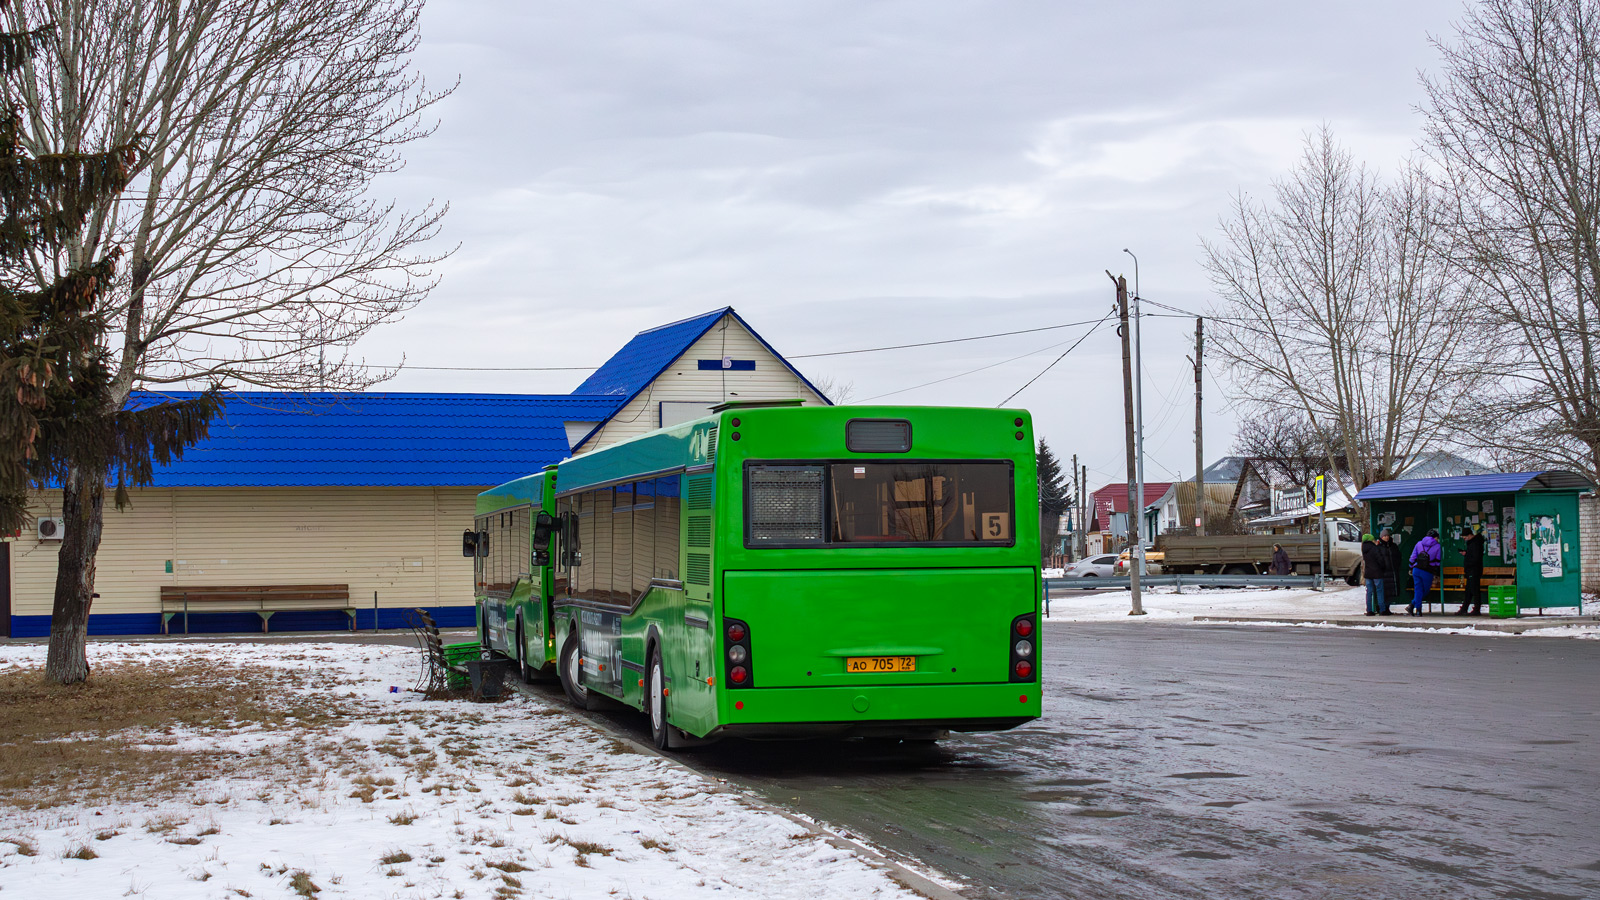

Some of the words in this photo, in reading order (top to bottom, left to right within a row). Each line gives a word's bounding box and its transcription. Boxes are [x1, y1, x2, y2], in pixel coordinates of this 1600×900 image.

[989, 516, 1001, 536] 5
[872, 658, 894, 670] 705
[900, 657, 912, 667] 72
